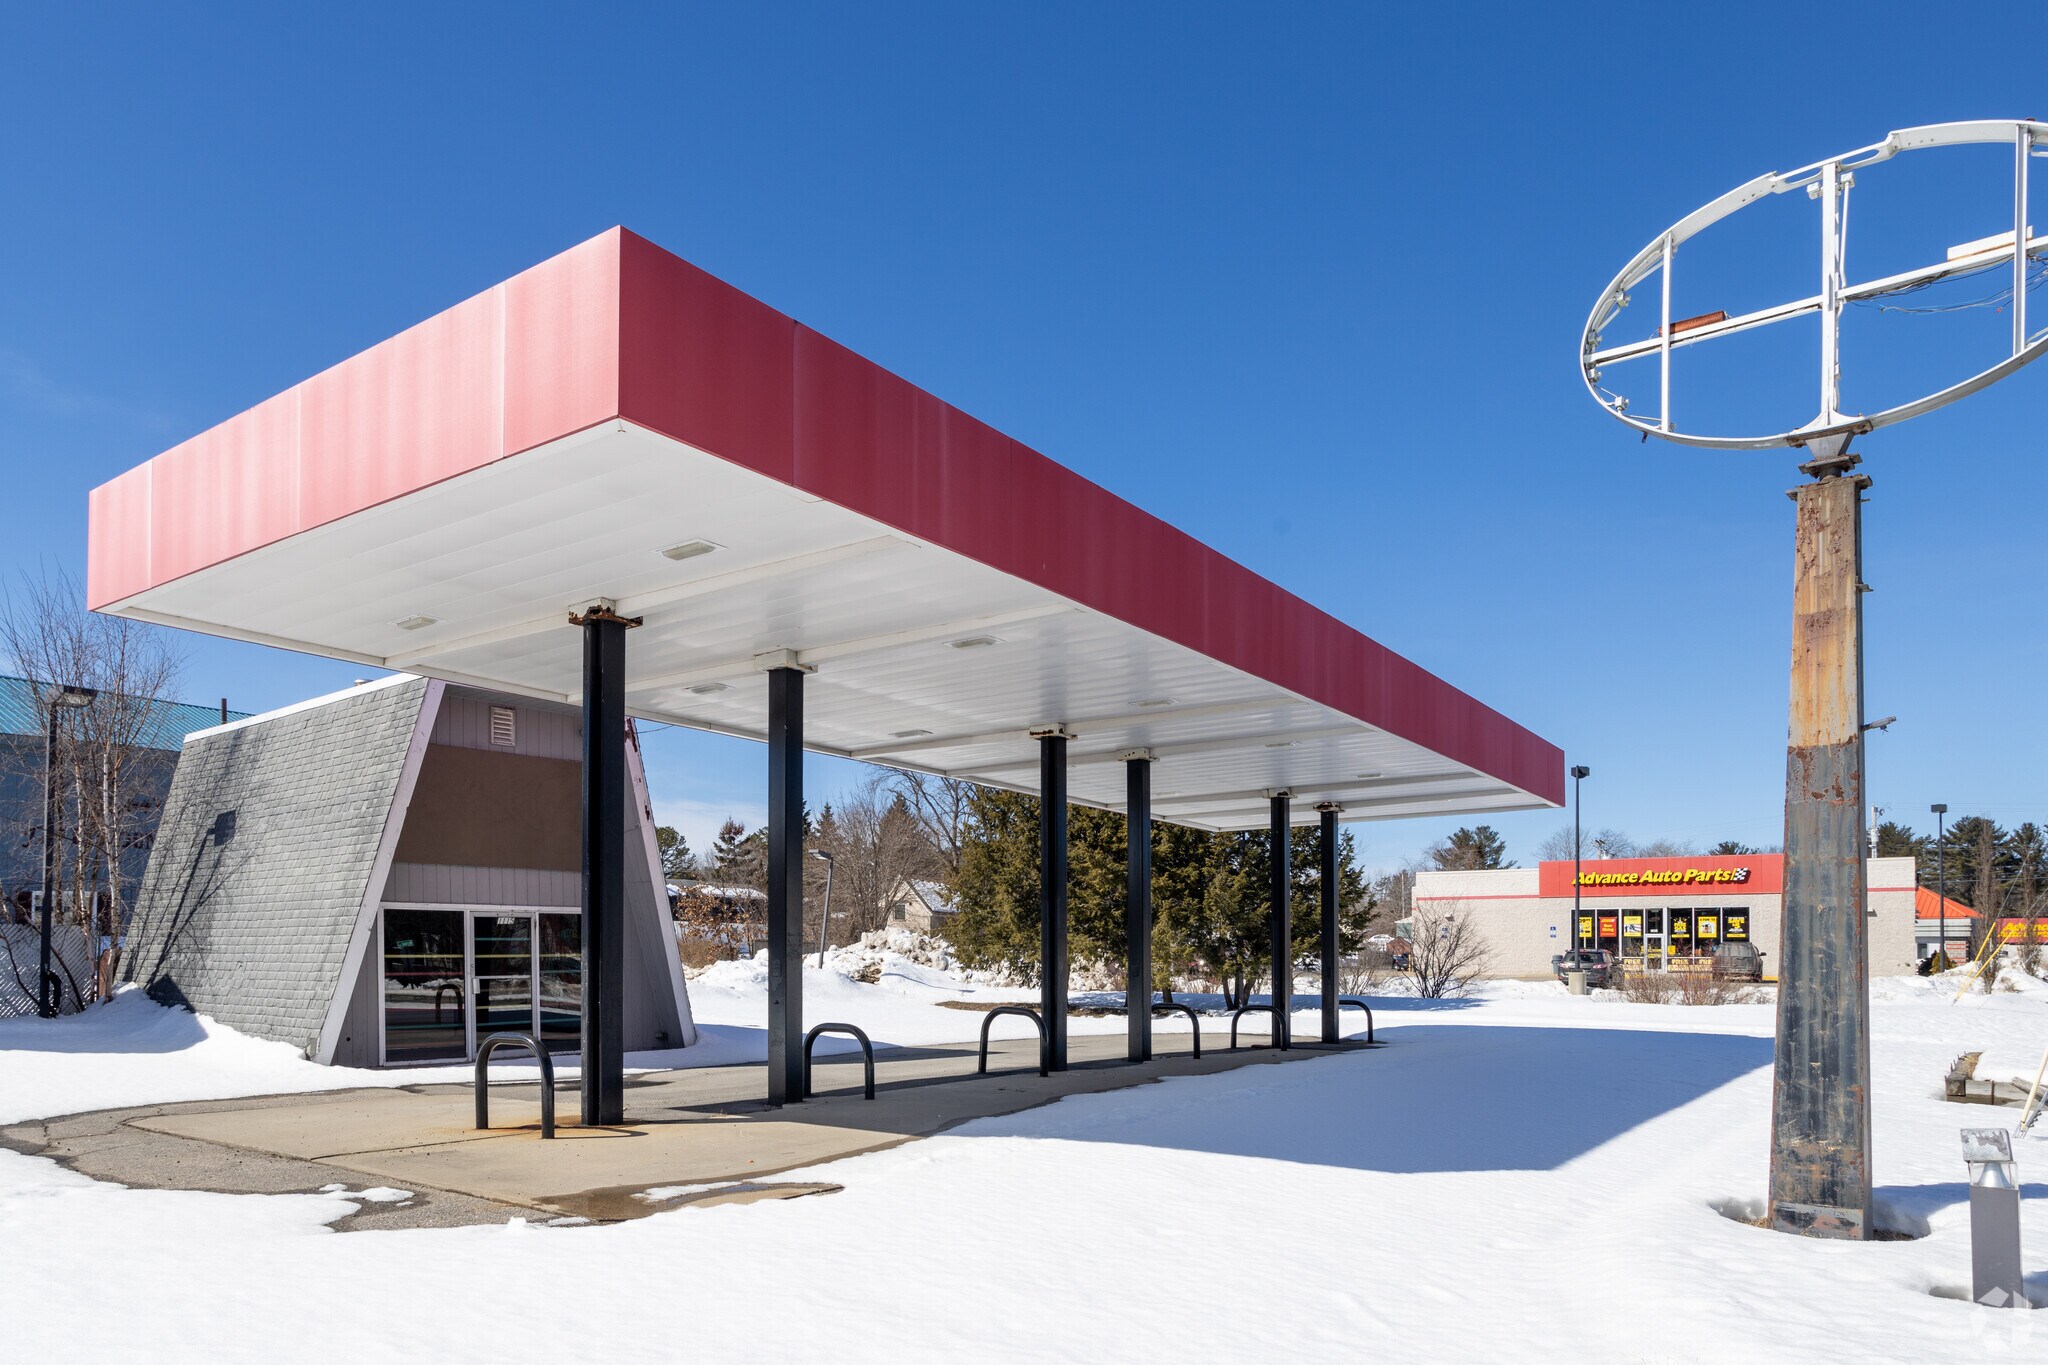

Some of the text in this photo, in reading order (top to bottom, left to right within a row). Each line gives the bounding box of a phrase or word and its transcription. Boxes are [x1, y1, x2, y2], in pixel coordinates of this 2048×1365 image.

[1572, 868, 1733, 885] Advance Auto Parts
